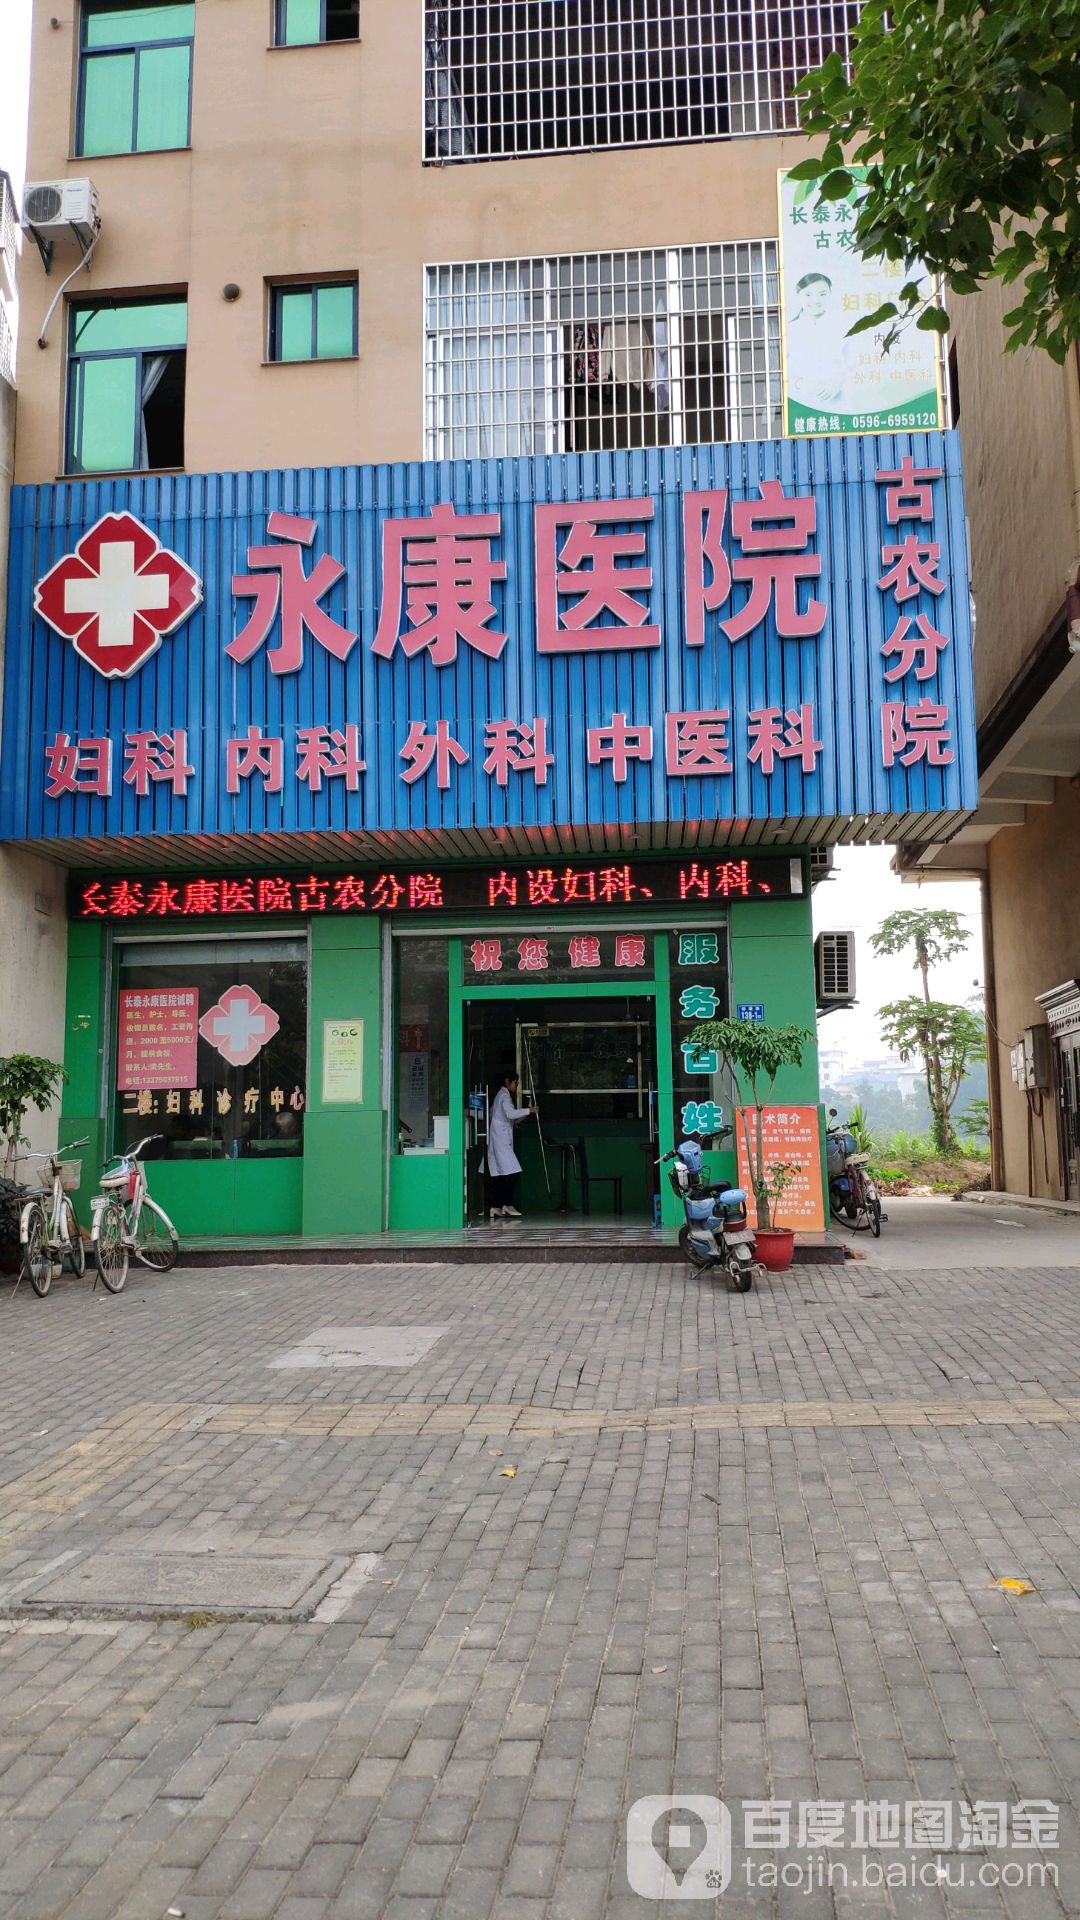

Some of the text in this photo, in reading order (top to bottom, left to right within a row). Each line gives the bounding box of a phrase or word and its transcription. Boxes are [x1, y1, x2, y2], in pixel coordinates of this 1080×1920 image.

[813, 229, 856, 250] 古农
[852, 412, 937, 429] 0596-6959120
[223, 479, 828, 677] 永康医院
[875, 455, 956, 768] 古农分院
[44, 703, 824, 800] 妇科 内科 外科 中医科
[470, 934, 647, 972] 祝您健康
[678, 932, 723, 1136] 服务百姓
